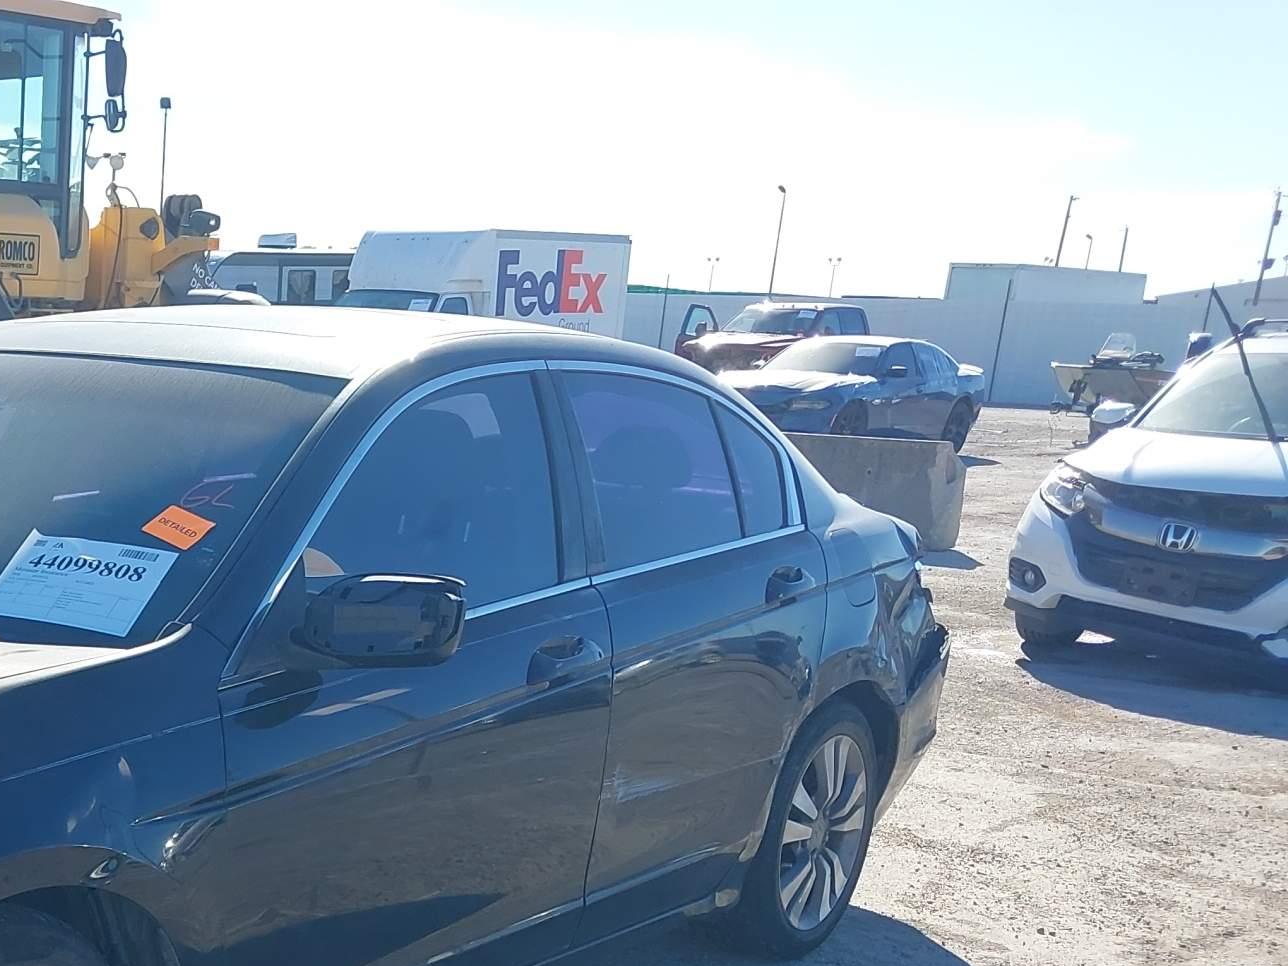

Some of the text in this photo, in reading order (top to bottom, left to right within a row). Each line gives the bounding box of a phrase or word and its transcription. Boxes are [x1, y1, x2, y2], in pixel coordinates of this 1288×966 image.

[192, 263, 205, 279] NO
[495, 249, 608, 317] FedEx
[158, 517, 198, 538] DETAILED
[29, 553, 147, 582] 44099808
